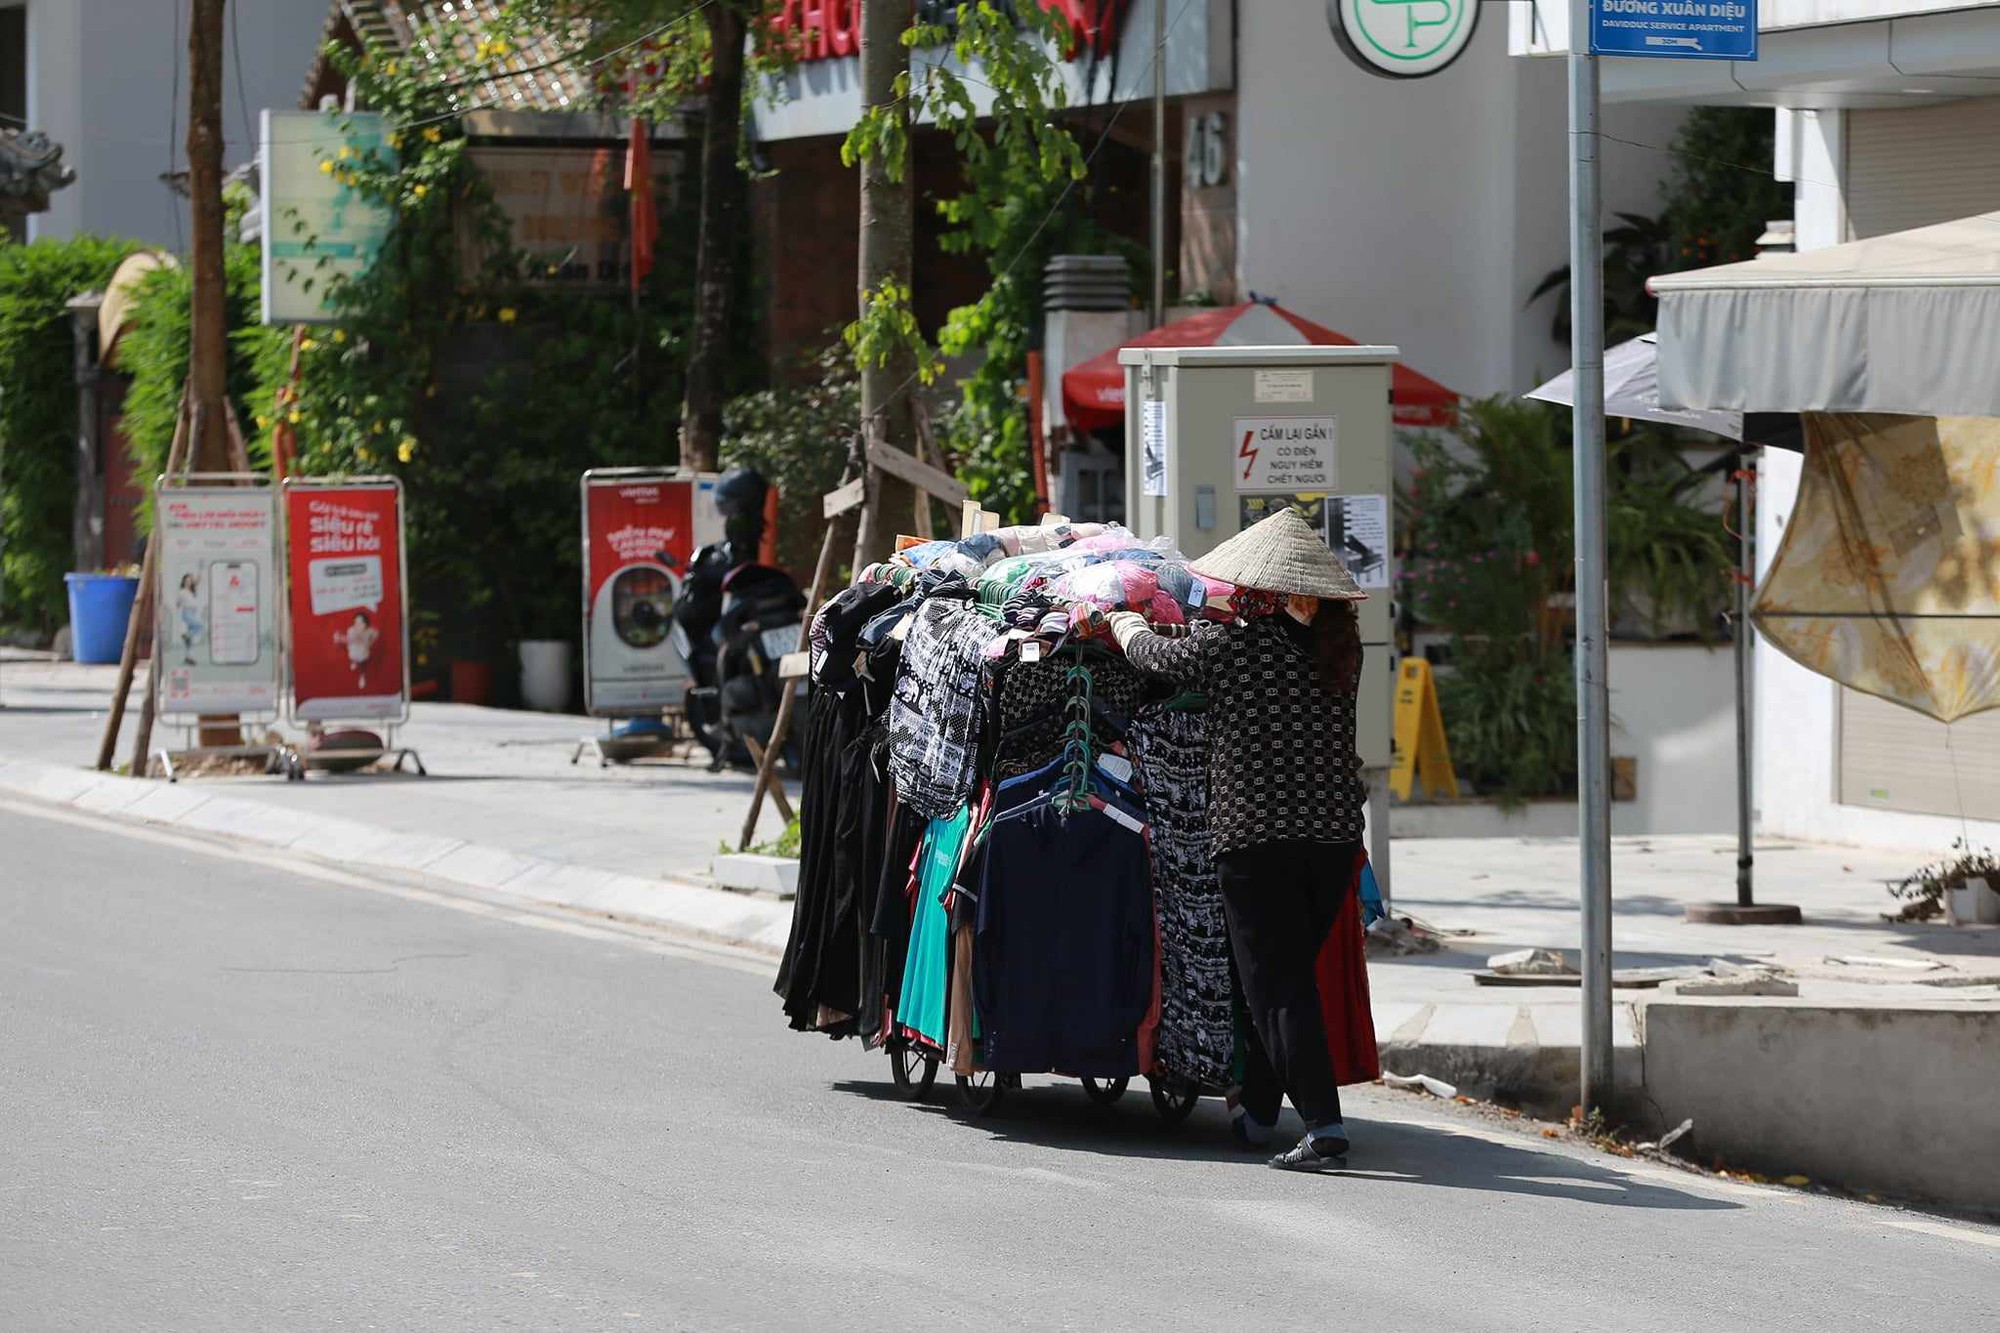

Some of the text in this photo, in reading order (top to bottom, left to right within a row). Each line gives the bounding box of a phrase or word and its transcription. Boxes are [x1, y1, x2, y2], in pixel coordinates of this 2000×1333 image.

[1661, 0, 1706, 16] XUÂN
[1709, 1, 1746, 20] DIỆU
[1650, 22, 1687, 30] SERVICE
[1688, 23, 1746, 33] APARTMENT
[1260, 423, 1283, 440] CẤM
[1269, 460, 1298, 470] NGUY
